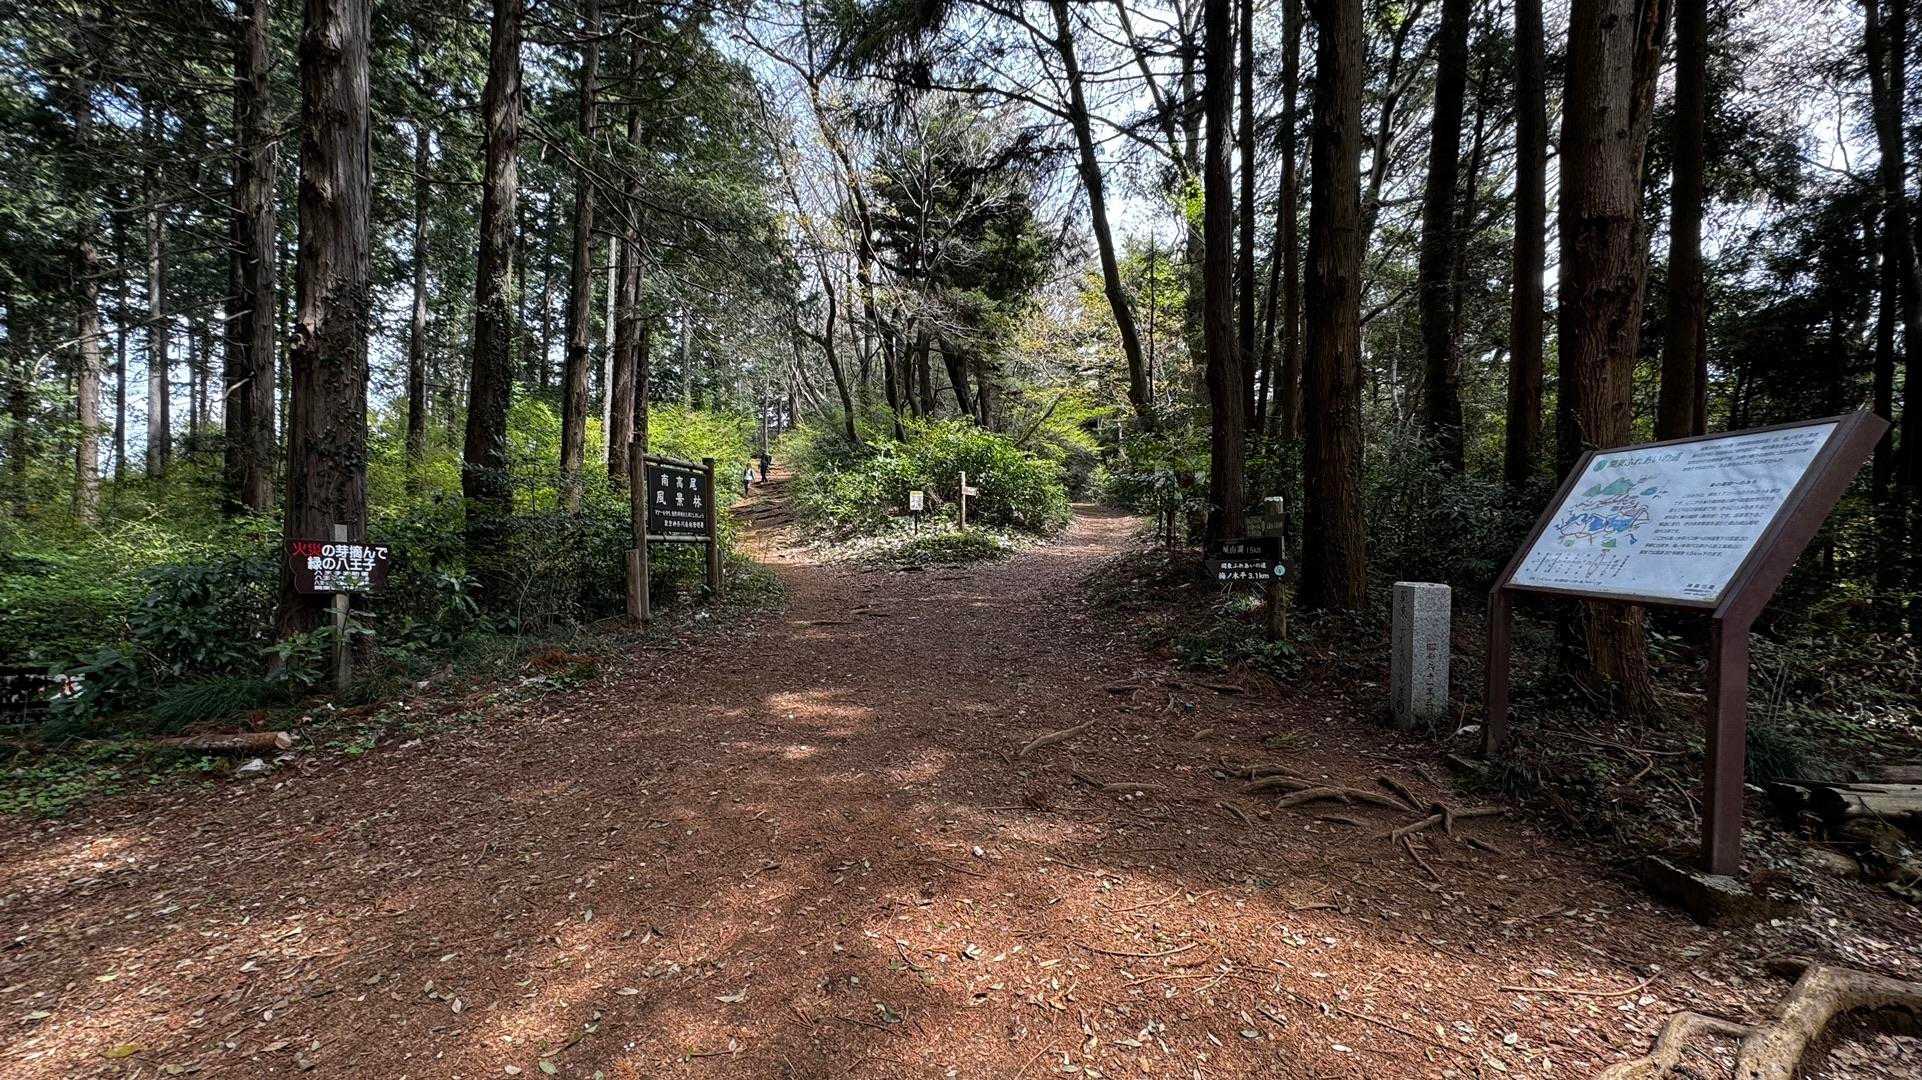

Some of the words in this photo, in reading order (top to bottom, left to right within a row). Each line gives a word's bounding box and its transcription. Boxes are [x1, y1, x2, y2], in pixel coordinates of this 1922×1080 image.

[661, 473, 697, 490] 南高尾
[656, 491, 702, 508] 風景林
[292, 543, 388, 559] 火災の芽摘んで
[307, 556, 376, 570] 緑の八王子
[1218, 571, 1247, 580] 梅ノ木平
[1248, 571, 1270, 580] 3.1km
